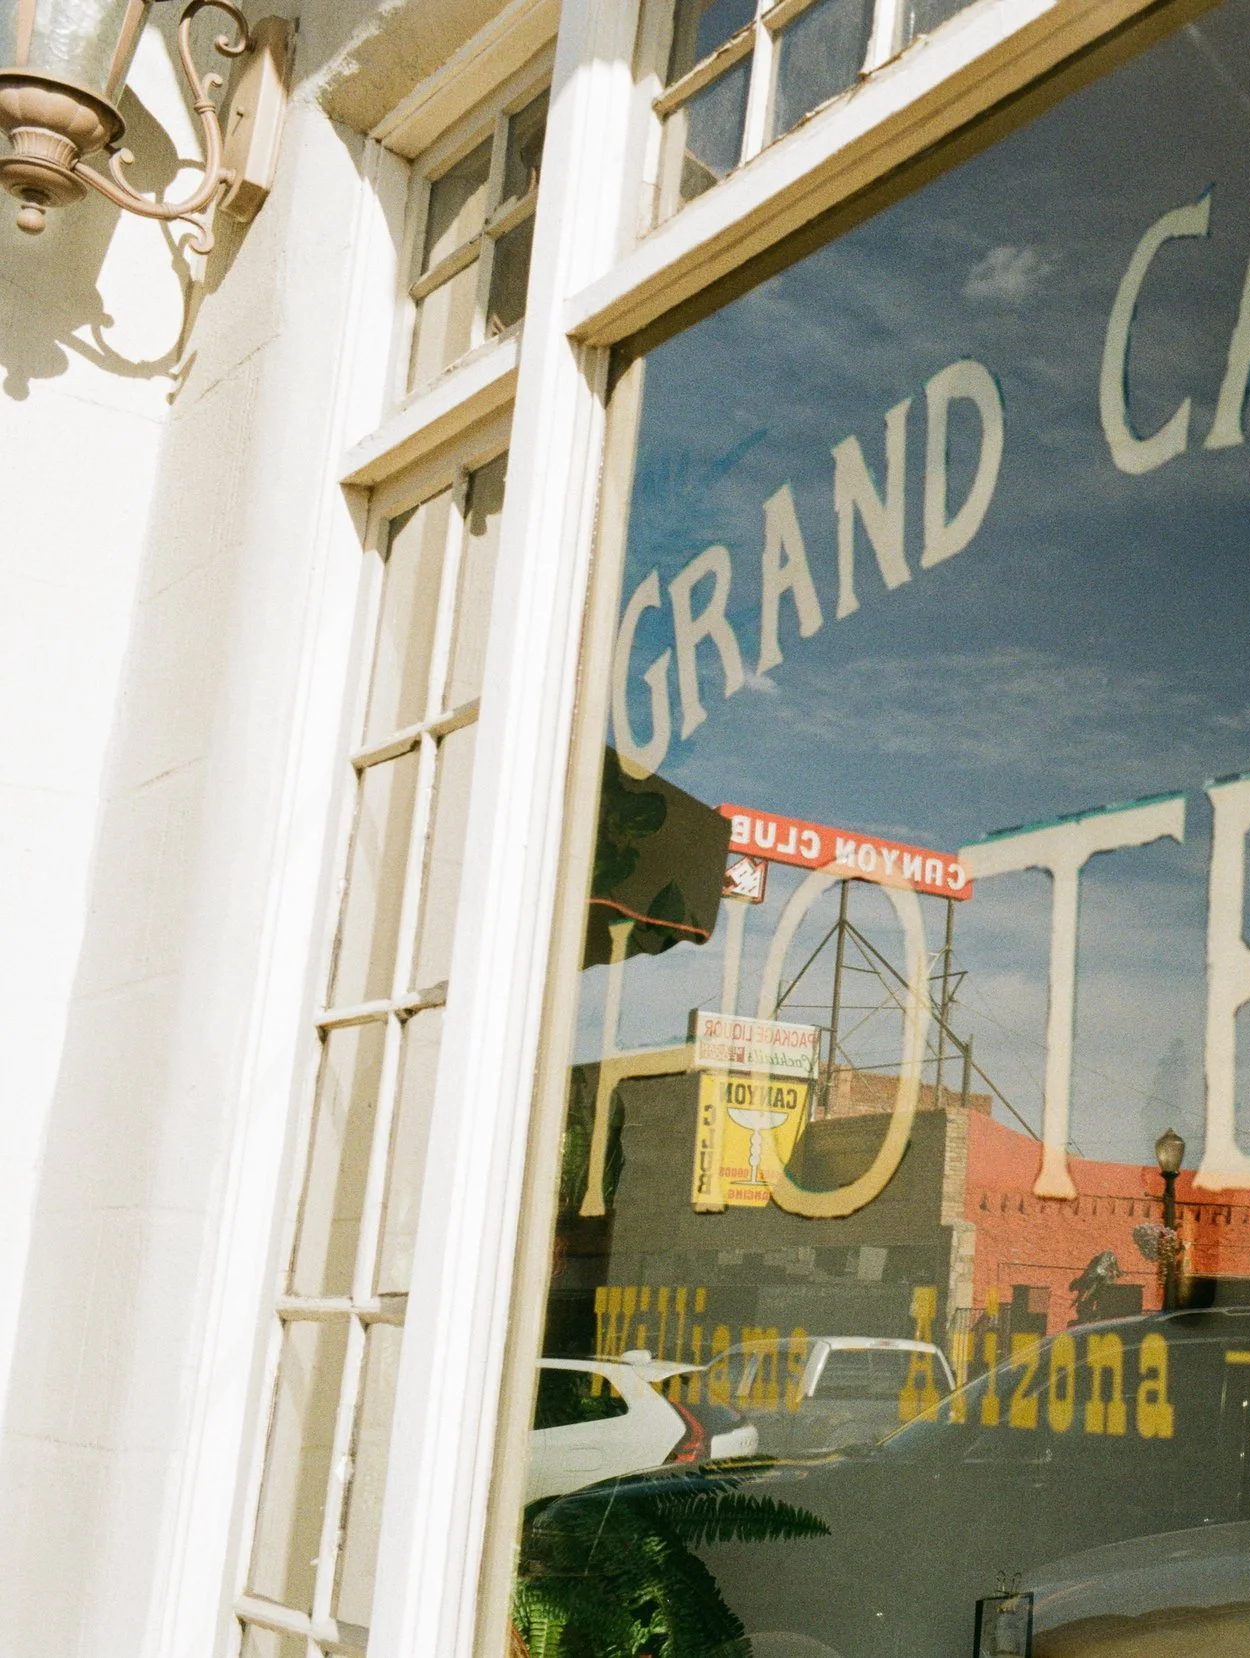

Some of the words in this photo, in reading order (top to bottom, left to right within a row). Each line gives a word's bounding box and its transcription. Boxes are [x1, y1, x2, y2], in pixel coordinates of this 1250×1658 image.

[611, 357, 1006, 781] GRAND
[591, 1286, 808, 1413] Williams
[899, 1286, 1175, 1439] Arizona
